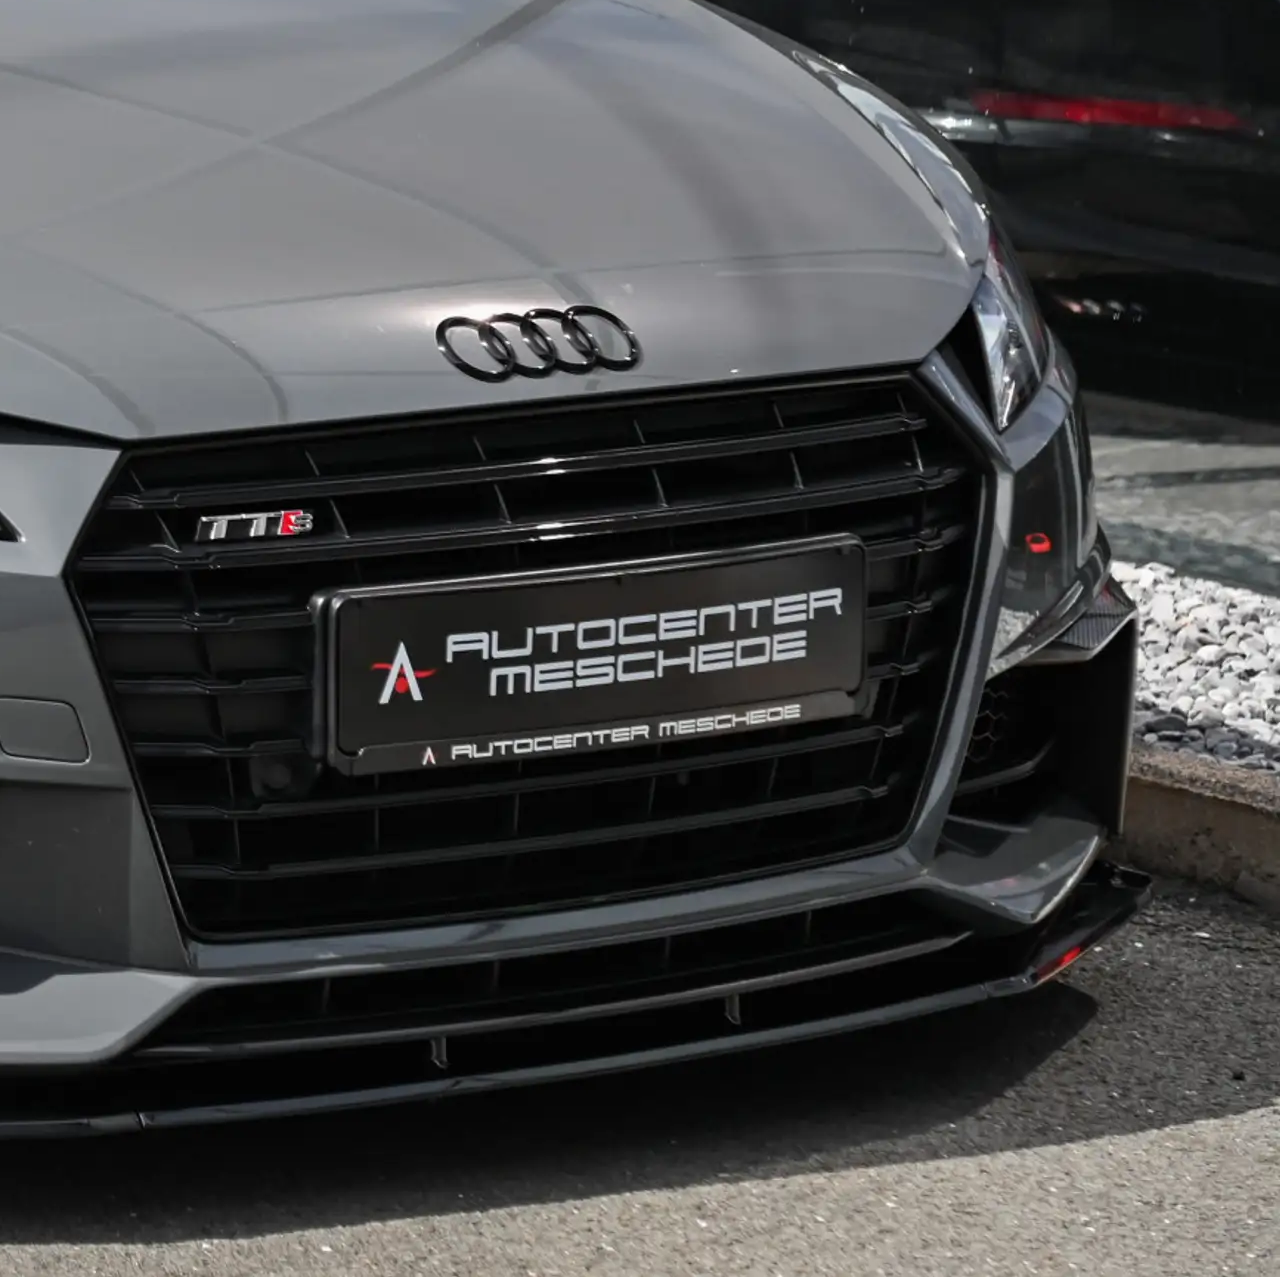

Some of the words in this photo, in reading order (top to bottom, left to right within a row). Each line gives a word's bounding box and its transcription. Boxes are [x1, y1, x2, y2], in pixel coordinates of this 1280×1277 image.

[446, 587, 843, 663] AUTOCENTER
[489, 629, 808, 697] MESCHEDE
[451, 725, 650, 761] AUTOCENTER
[658, 704, 802, 738] MESCHEDE
